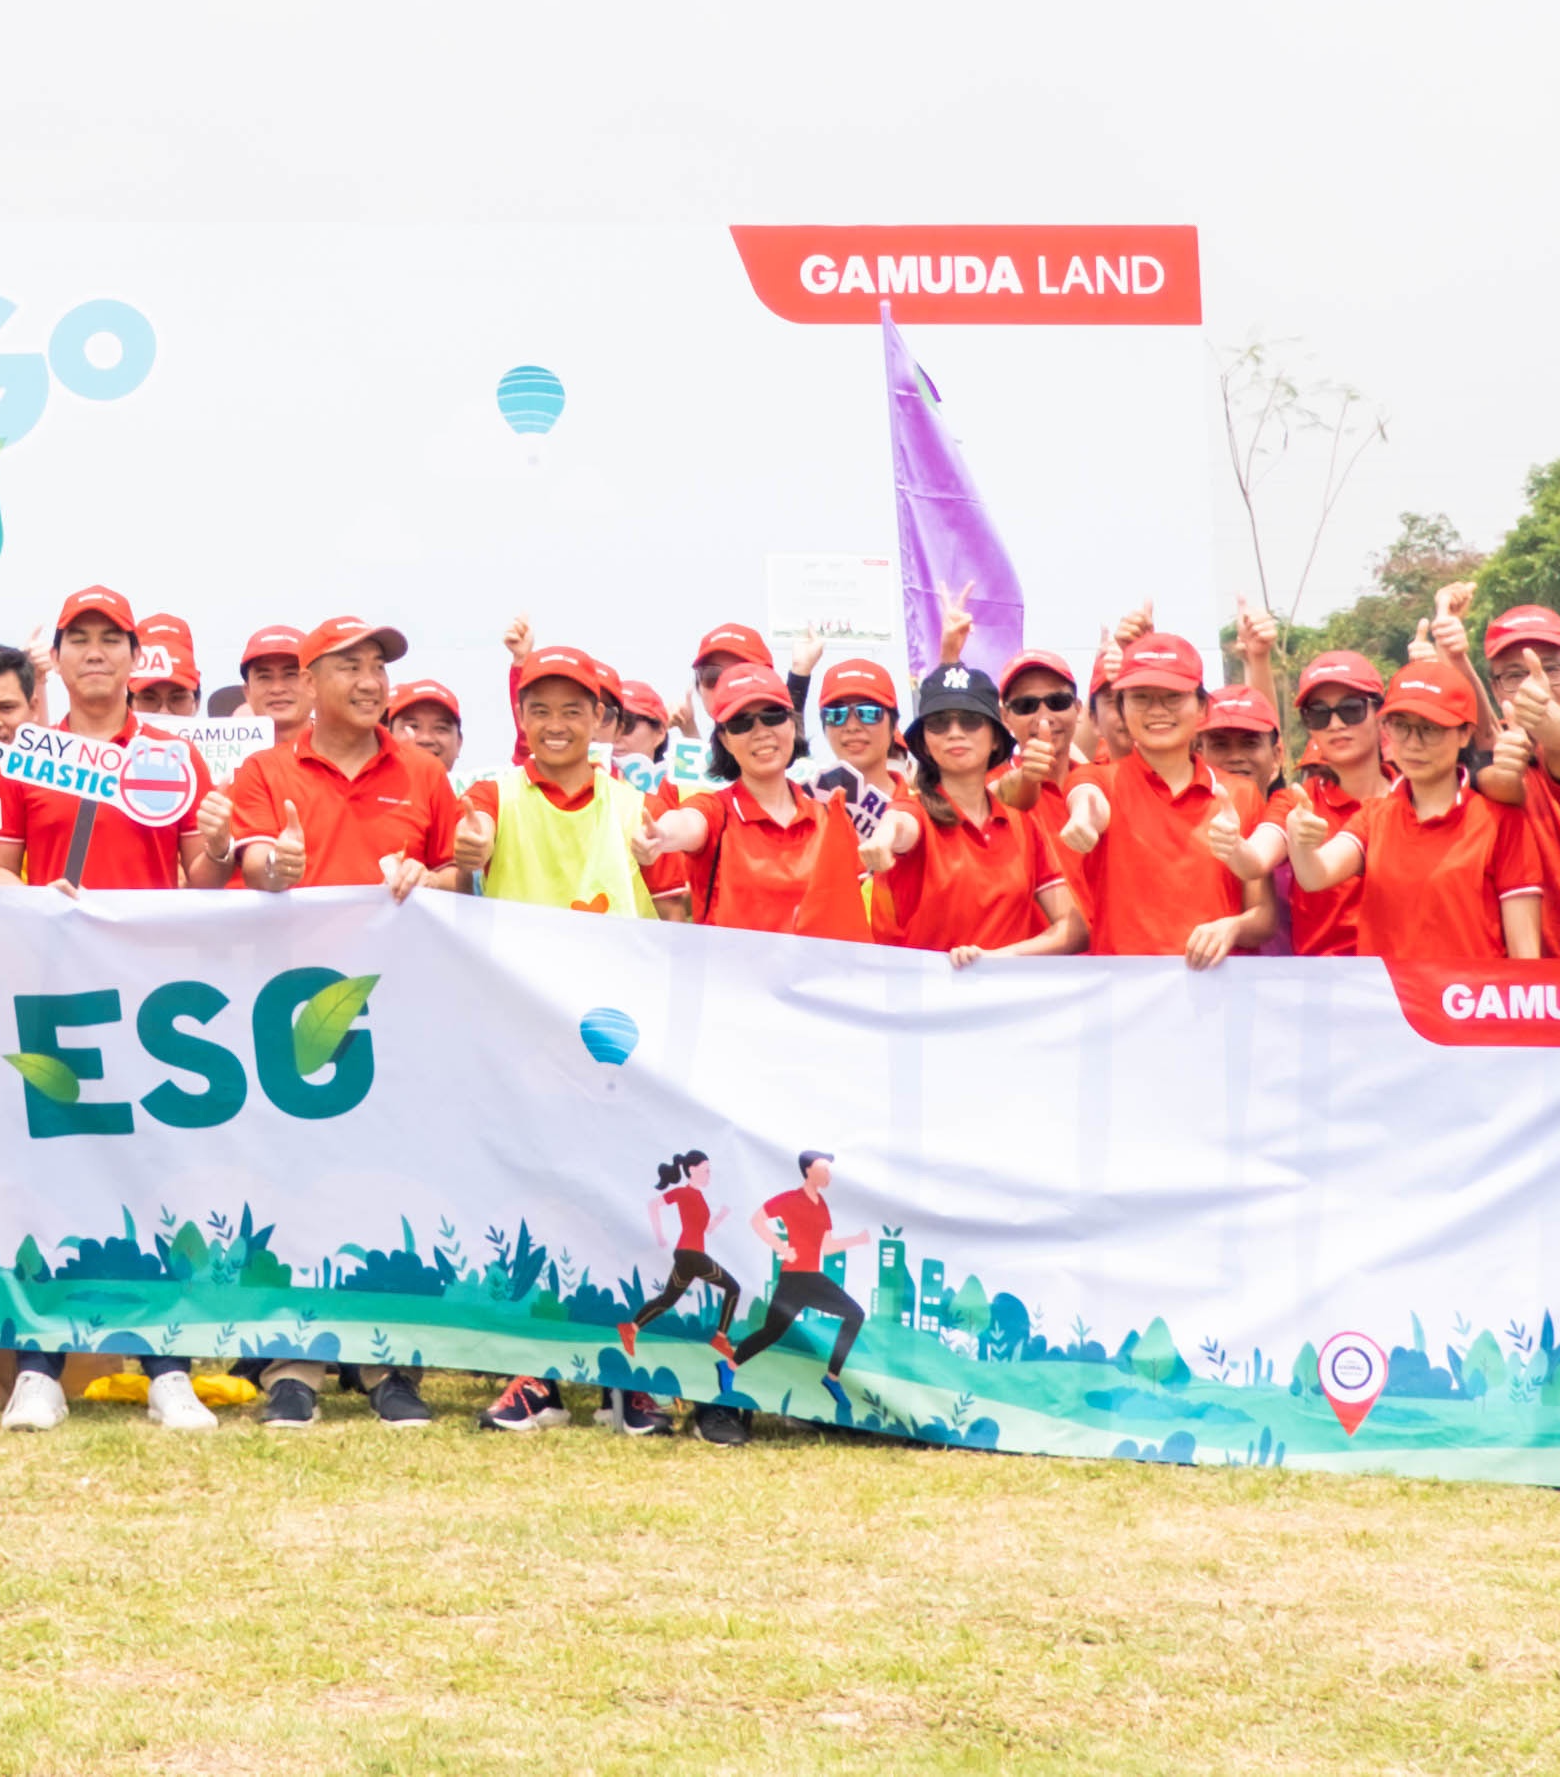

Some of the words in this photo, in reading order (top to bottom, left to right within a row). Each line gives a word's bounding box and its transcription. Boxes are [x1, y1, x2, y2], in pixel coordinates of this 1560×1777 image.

[799, 254, 1024, 295] GAMUDA
[1038, 254, 1165, 295] LAND
[18, 728, 73, 759] SAY
[78, 743, 122, 771] NO
[178, 727, 263, 741] GAMUDA
[198, 744, 241, 759] EEN
[7, 752, 118, 798] PLASTIC
[3, 965, 380, 1142] ESG
